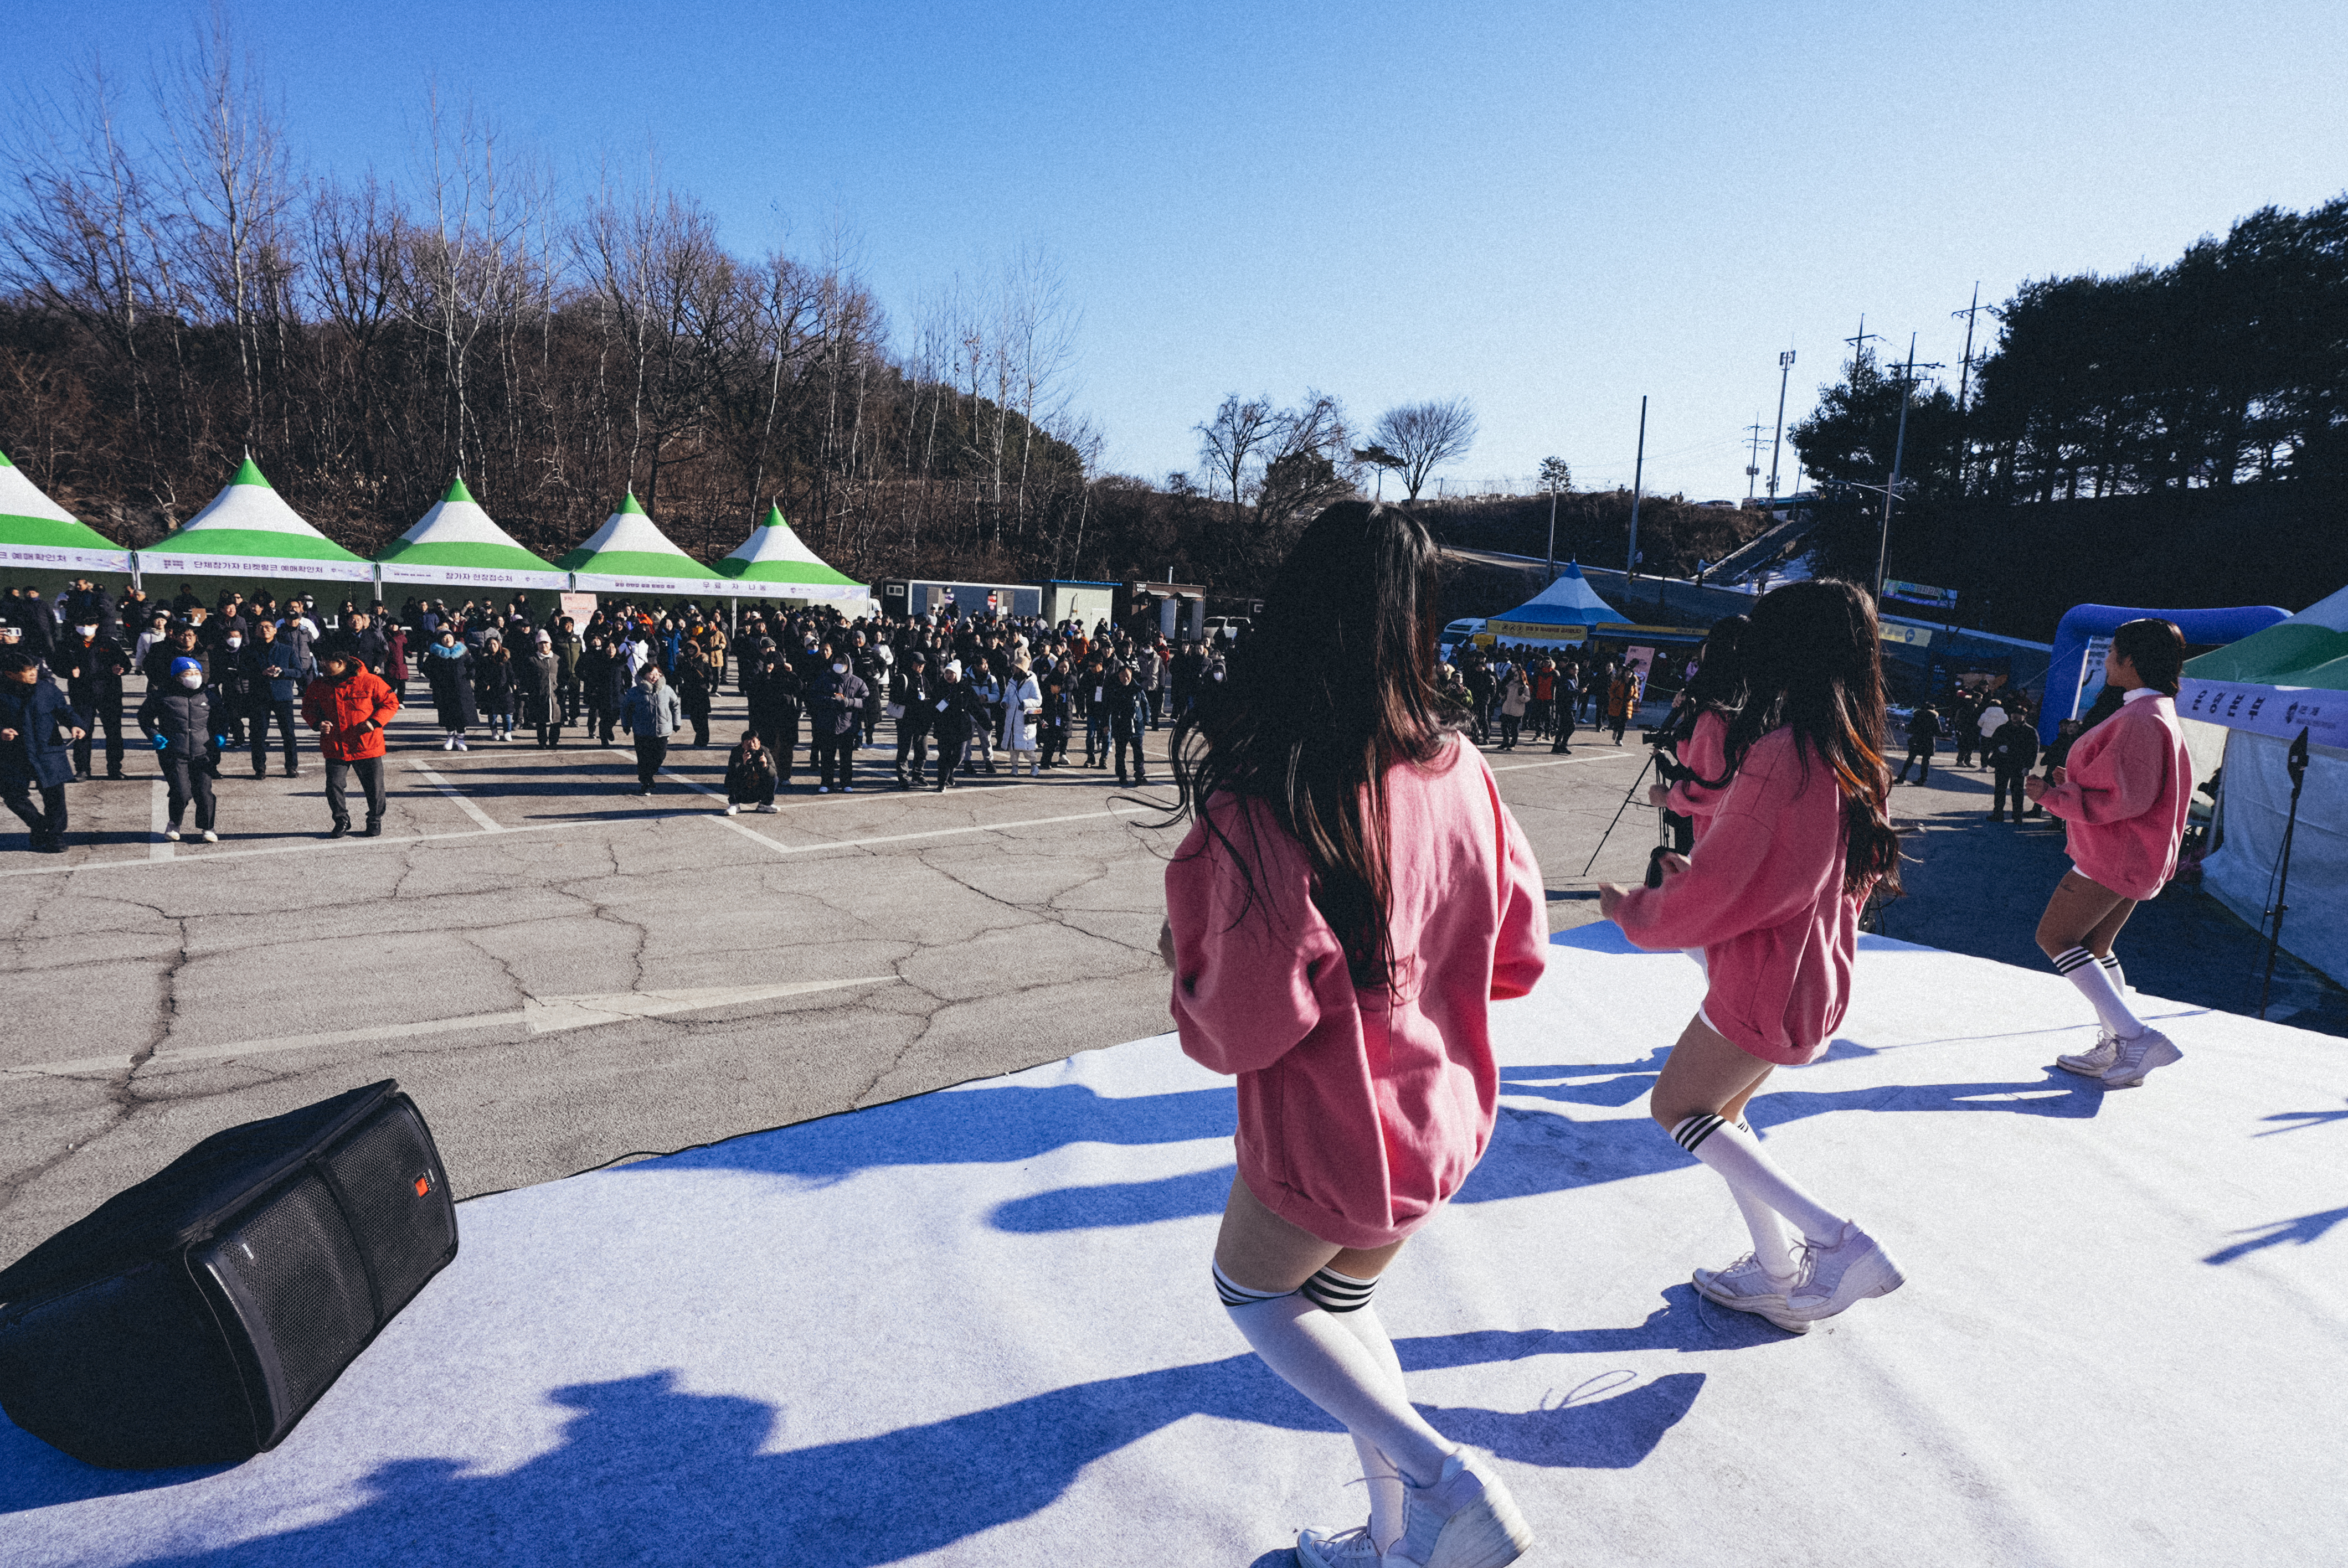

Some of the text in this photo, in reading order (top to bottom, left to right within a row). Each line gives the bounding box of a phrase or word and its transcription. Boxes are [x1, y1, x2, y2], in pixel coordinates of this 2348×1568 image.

[12, 552, 66, 563] 예매확인처
[194, 561, 240, 570] 단체참가자
[243, 563, 278, 571] 티켓링크
[281, 565, 323, 574] 예매확인처
[473, 573, 512, 582] 현장접수처
